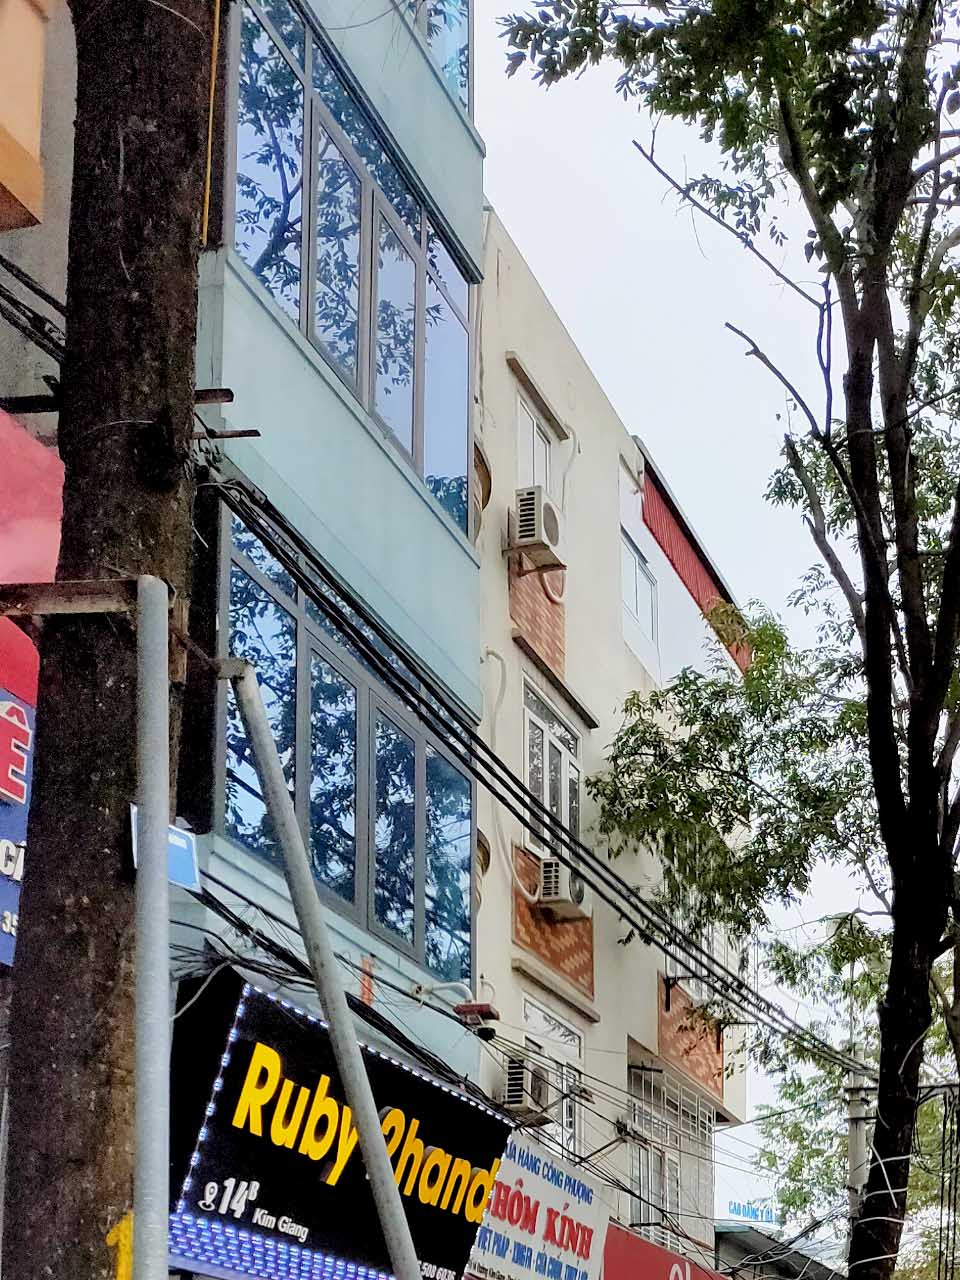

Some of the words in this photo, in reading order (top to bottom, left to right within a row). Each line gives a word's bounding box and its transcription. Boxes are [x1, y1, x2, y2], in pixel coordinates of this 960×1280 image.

[232, 1042, 358, 1186] Ruby
[252, 1207, 277, 1230] Kim
[277, 1215, 309, 1243] Giang
[543, 1201, 595, 1260] KÍNH
